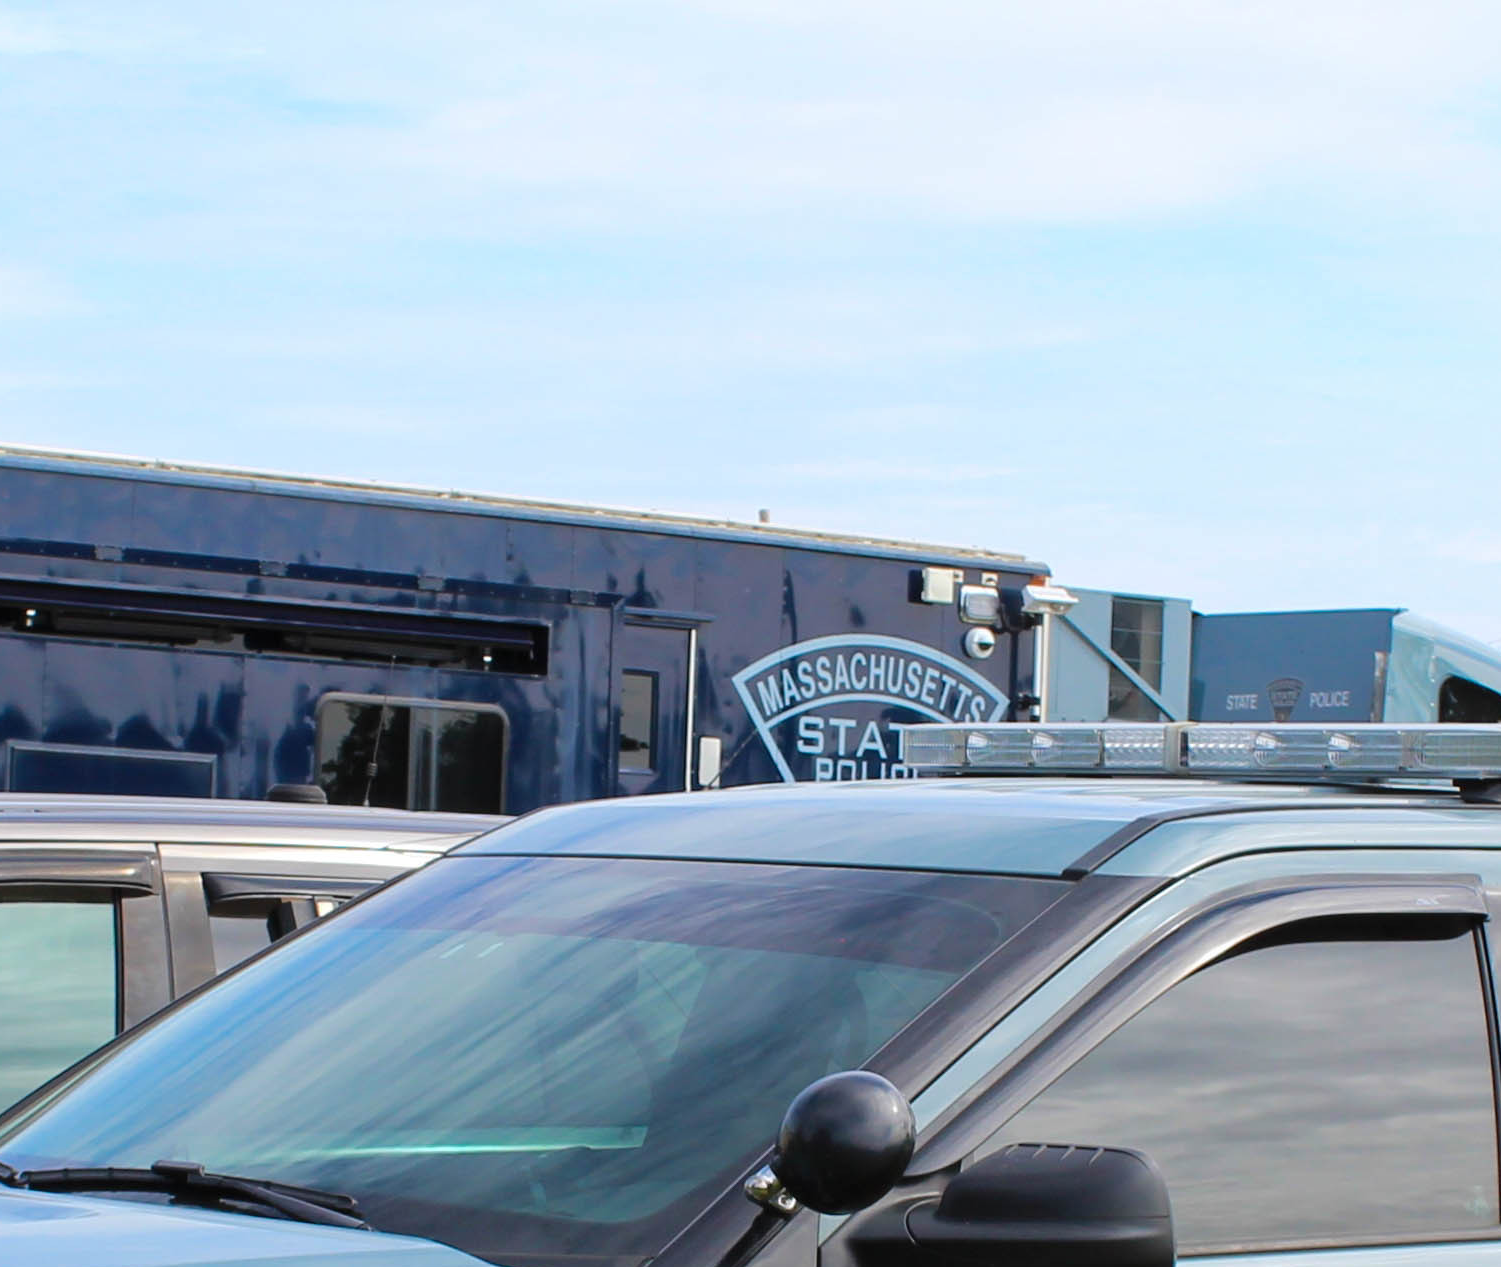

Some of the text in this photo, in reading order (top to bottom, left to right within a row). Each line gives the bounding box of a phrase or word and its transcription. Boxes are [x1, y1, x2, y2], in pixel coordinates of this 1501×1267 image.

[756, 652, 986, 722] MASSACHUSETTS
[1225, 690, 1350, 711] STATE POLICE
[797, 715, 905, 760] STAT
[815, 756, 919, 782] POLIC
